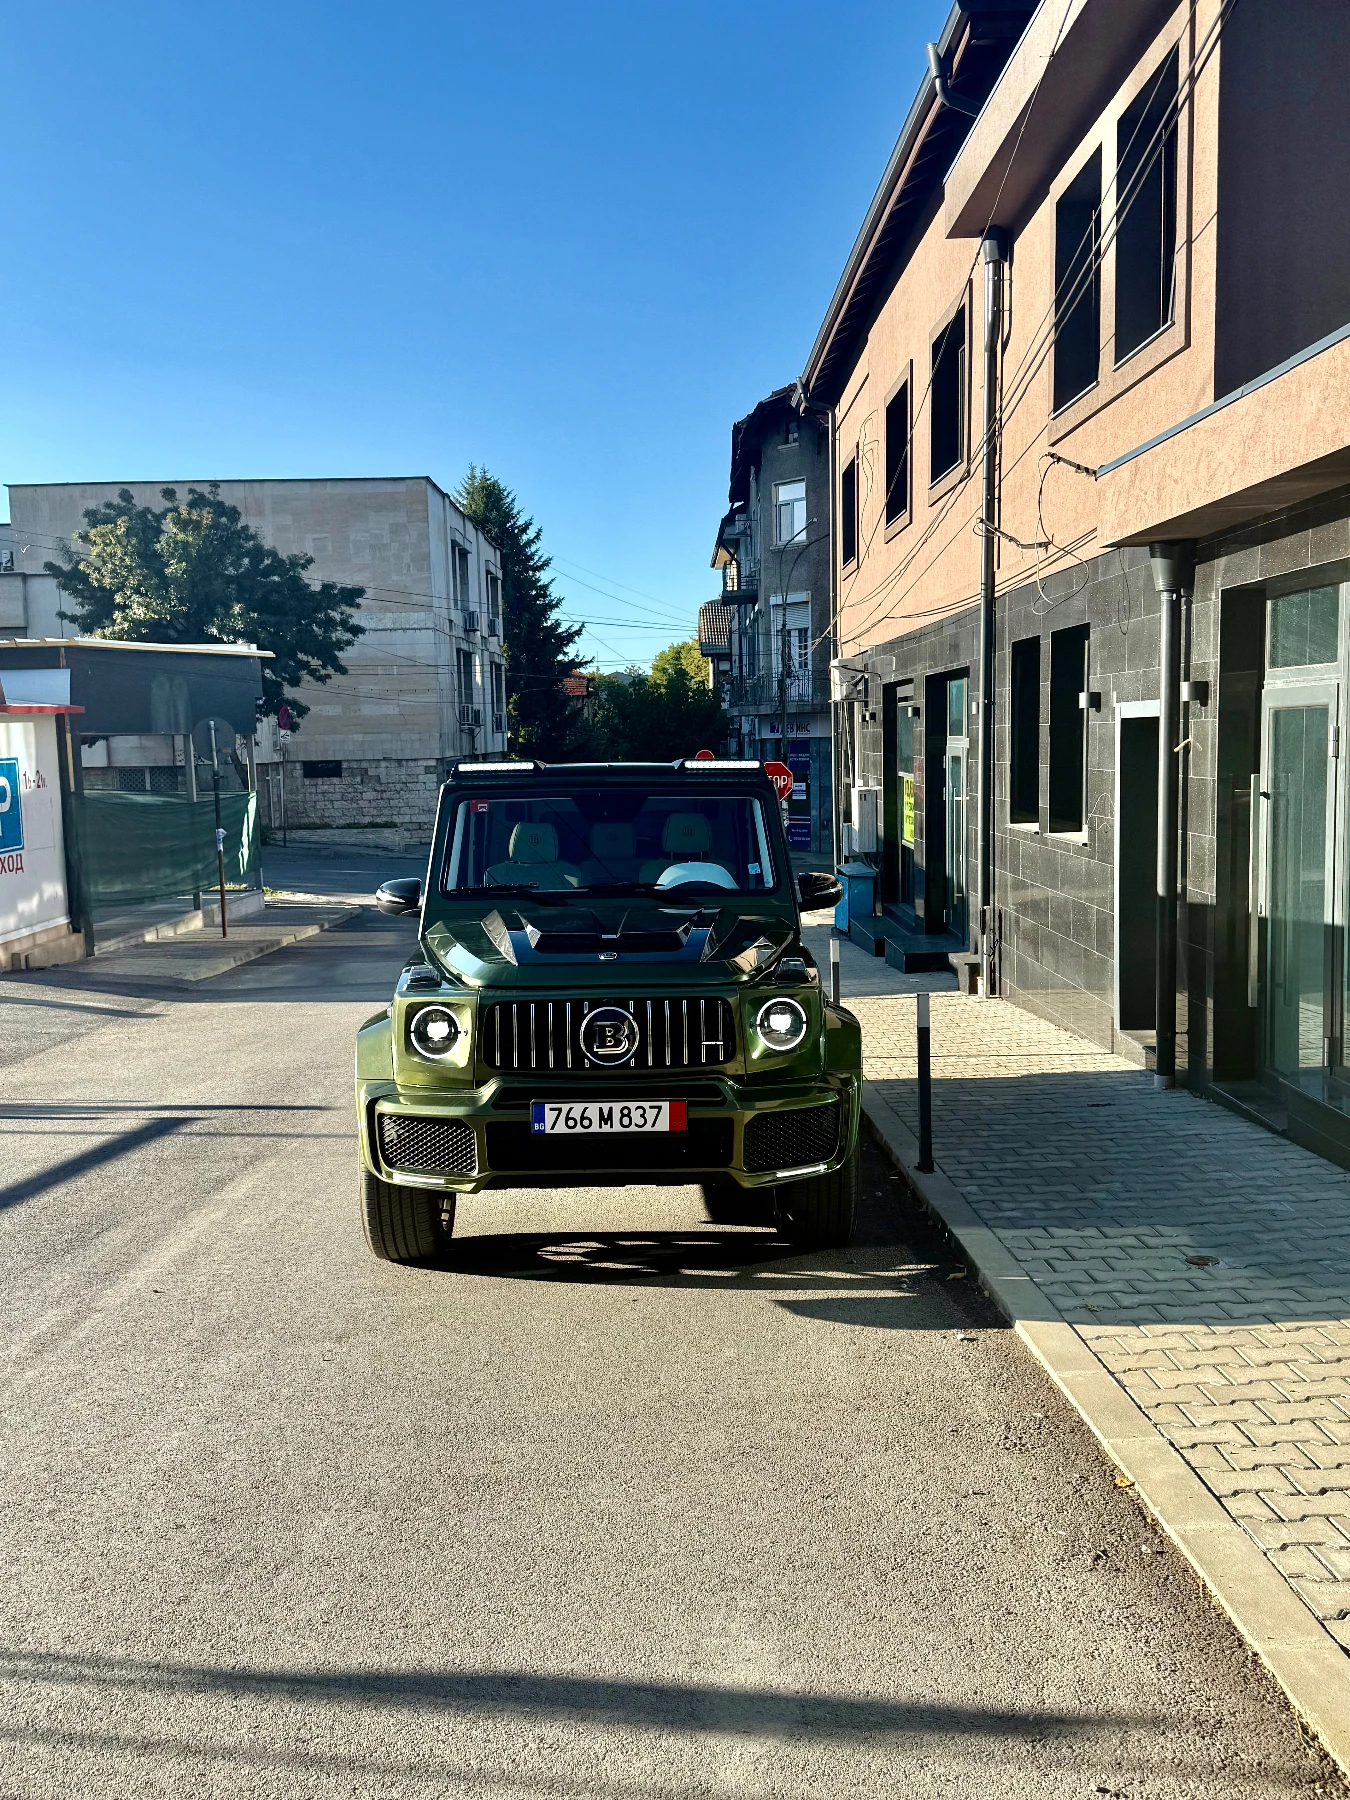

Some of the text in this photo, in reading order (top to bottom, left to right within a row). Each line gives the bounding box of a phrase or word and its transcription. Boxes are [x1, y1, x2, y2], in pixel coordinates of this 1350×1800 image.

[593, 1021, 629, 1055] B
[548, 1106, 593, 1130] 766
[598, 1106, 614, 1129] M
[619, 1105, 663, 1129] 837
